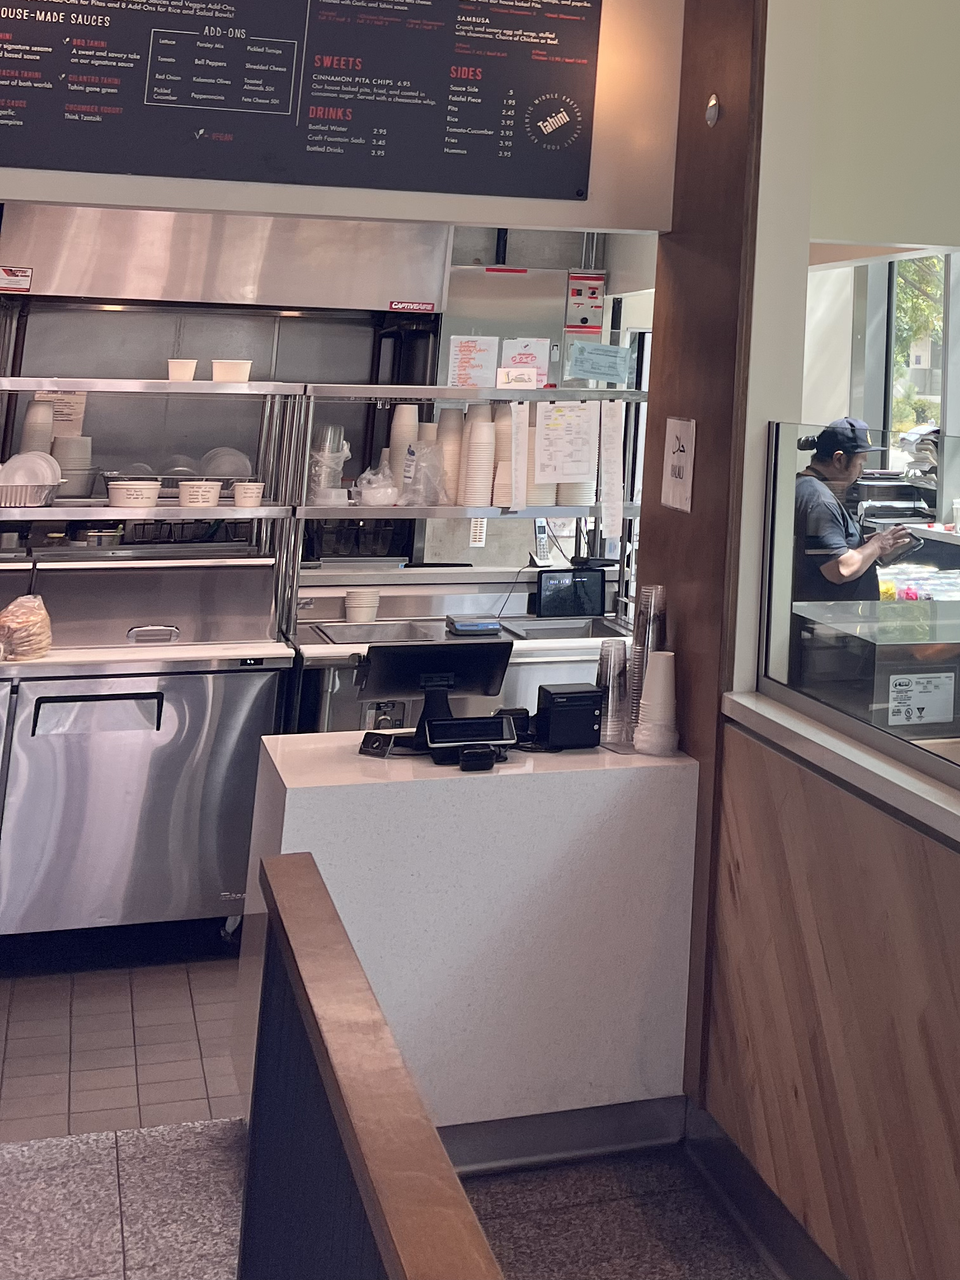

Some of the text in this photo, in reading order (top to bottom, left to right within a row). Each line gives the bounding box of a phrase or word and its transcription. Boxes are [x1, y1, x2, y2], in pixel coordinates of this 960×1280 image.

[127, 3, 155, 11] Add-Ons
[184, 0, 205, 8] Veggie
[0, 7, 110, 26] OUSE-MADE SAUCES
[456, 15, 489, 23] SAMBUSA
[203, 25, 245, 38] ADD-ONS
[314, 54, 362, 70] SWEETS
[312, 73, 352, 82] CINNAMON
[450, 65, 482, 79] SIDES
[309, 106, 352, 120] DRINKS
[534, 93, 558, 105] MIDDLE
[562, 95, 582, 121] EASTERN
[537, 108, 570, 135] Tahini
[446, 126, 494, 134] Tomato-Cucumber
[306, 144, 325, 152] Bottled
